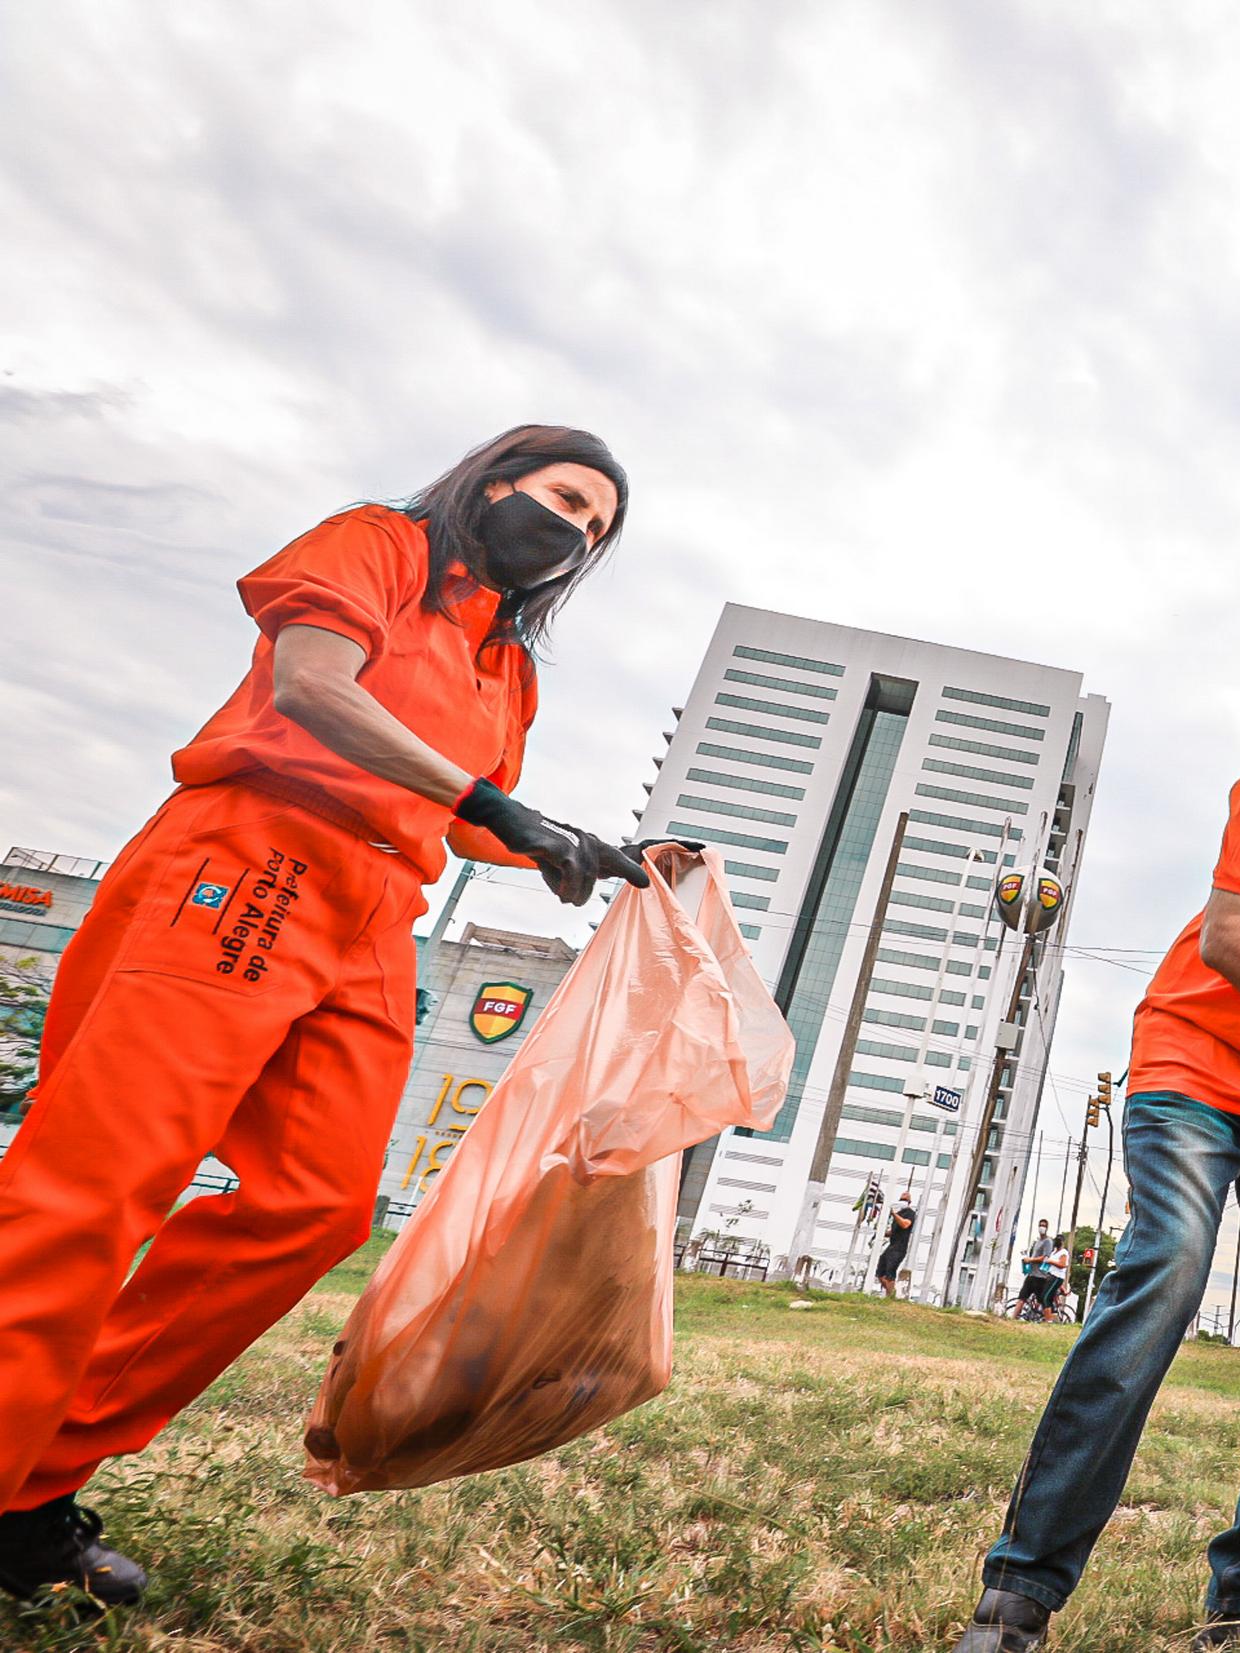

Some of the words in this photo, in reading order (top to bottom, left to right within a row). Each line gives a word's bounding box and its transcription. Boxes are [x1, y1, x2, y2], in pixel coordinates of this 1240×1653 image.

[0, 882, 53, 908] MISA
[257, 858, 308, 950] Prefeitura
[216, 902, 264, 974] Alegre
[243, 955, 268, 982] de
[483, 1001, 517, 1014] FGF
[935, 1089, 959, 1107] 1700
